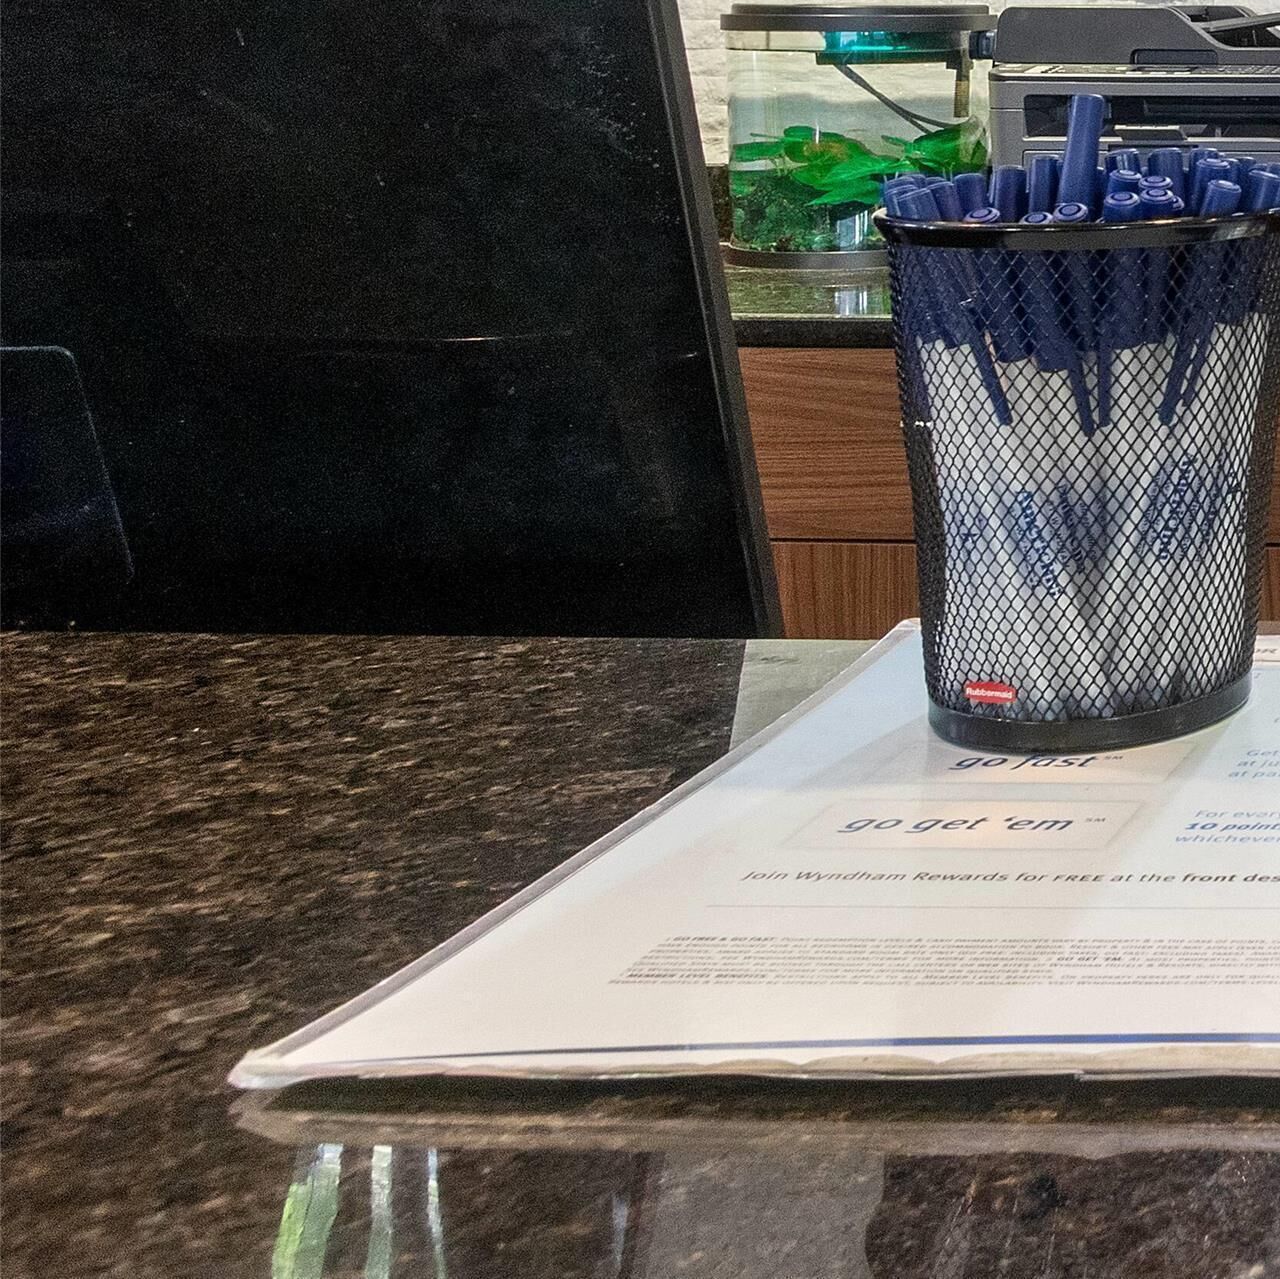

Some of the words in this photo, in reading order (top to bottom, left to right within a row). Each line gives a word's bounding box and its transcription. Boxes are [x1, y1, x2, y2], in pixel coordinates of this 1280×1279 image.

[966, 687, 1013, 699] Rubbermaid
[949, 756, 1009, 770] go
[1010, 755, 1099, 770] fast
[837, 818, 904, 833] go
[903, 816, 990, 833] get
[1185, 822, 1218, 830] 10
[739, 871, 789, 881] Join
[795, 871, 907, 882] Wyndham
[912, 872, 1009, 881] Rewards
[1014, 873, 1047, 882] for
[1052, 874, 1106, 882] FREE
[1110, 874, 1132, 882] at
[1138, 873, 1176, 882] the
[1182, 873, 1237, 882] front
